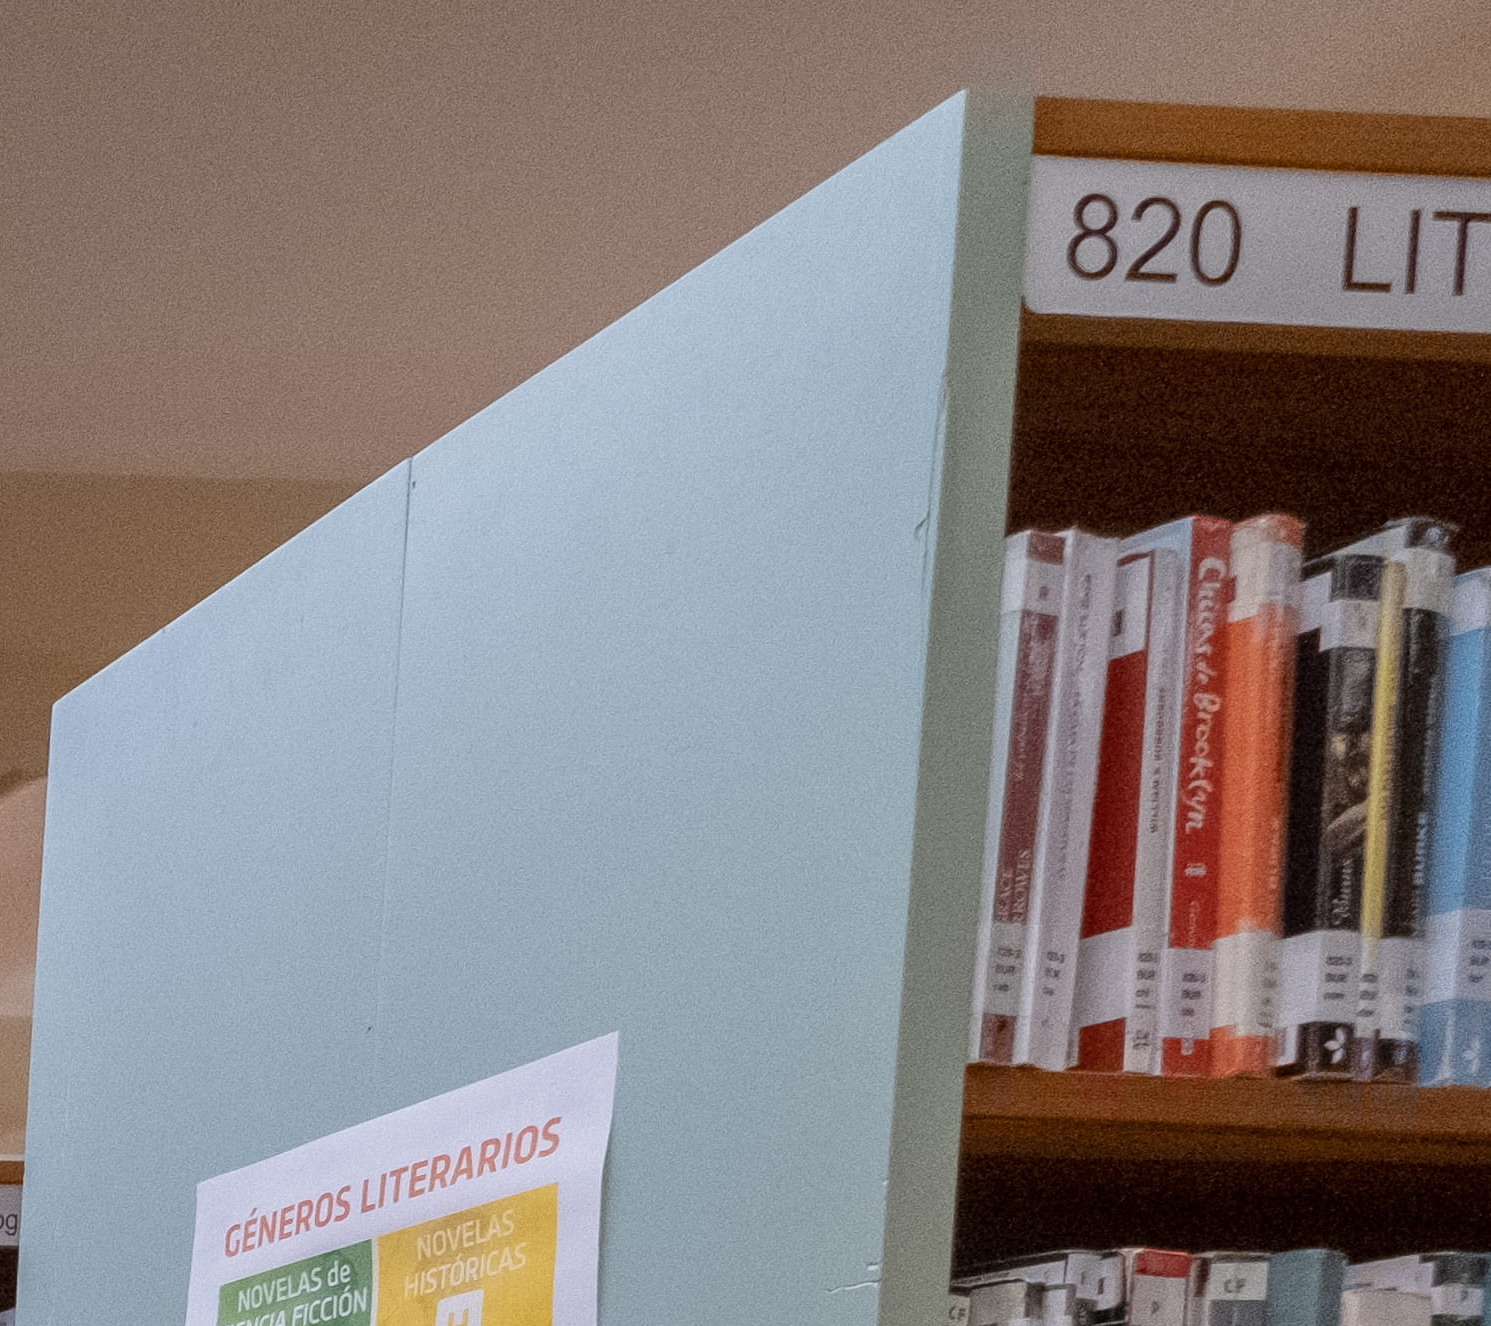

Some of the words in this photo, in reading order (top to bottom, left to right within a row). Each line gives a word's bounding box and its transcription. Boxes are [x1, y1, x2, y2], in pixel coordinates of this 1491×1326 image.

[1066, 193, 1243, 287] 820
[1341, 206, 1491, 296] LIT
[224, 1185, 351, 1258] GÉNEROS
[360, 1116, 562, 1215] LITERARIOS
[416, 1209, 516, 1261] NOVELAS
[237, 1268, 322, 1313] NOVELAS
[327, 1260, 352, 1290] de
[403, 1242, 527, 1298] HISTÓRICAS
